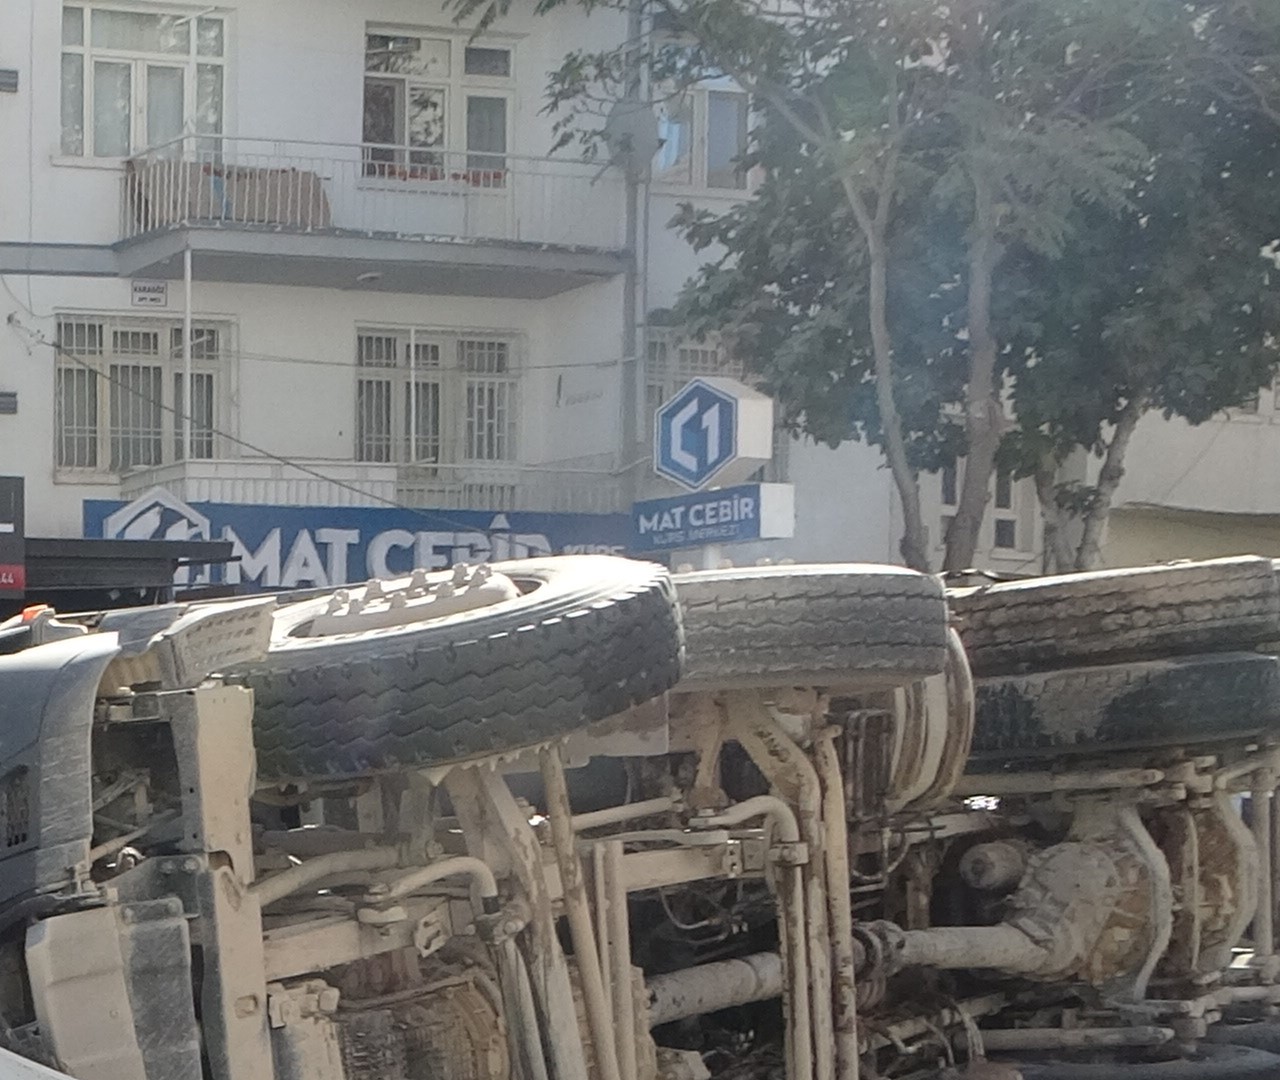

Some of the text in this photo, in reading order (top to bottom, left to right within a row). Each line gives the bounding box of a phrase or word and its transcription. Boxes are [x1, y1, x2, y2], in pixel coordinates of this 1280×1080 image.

[639, 493, 755, 534] MAT CEBİR
[221, 524, 360, 588] MAT
